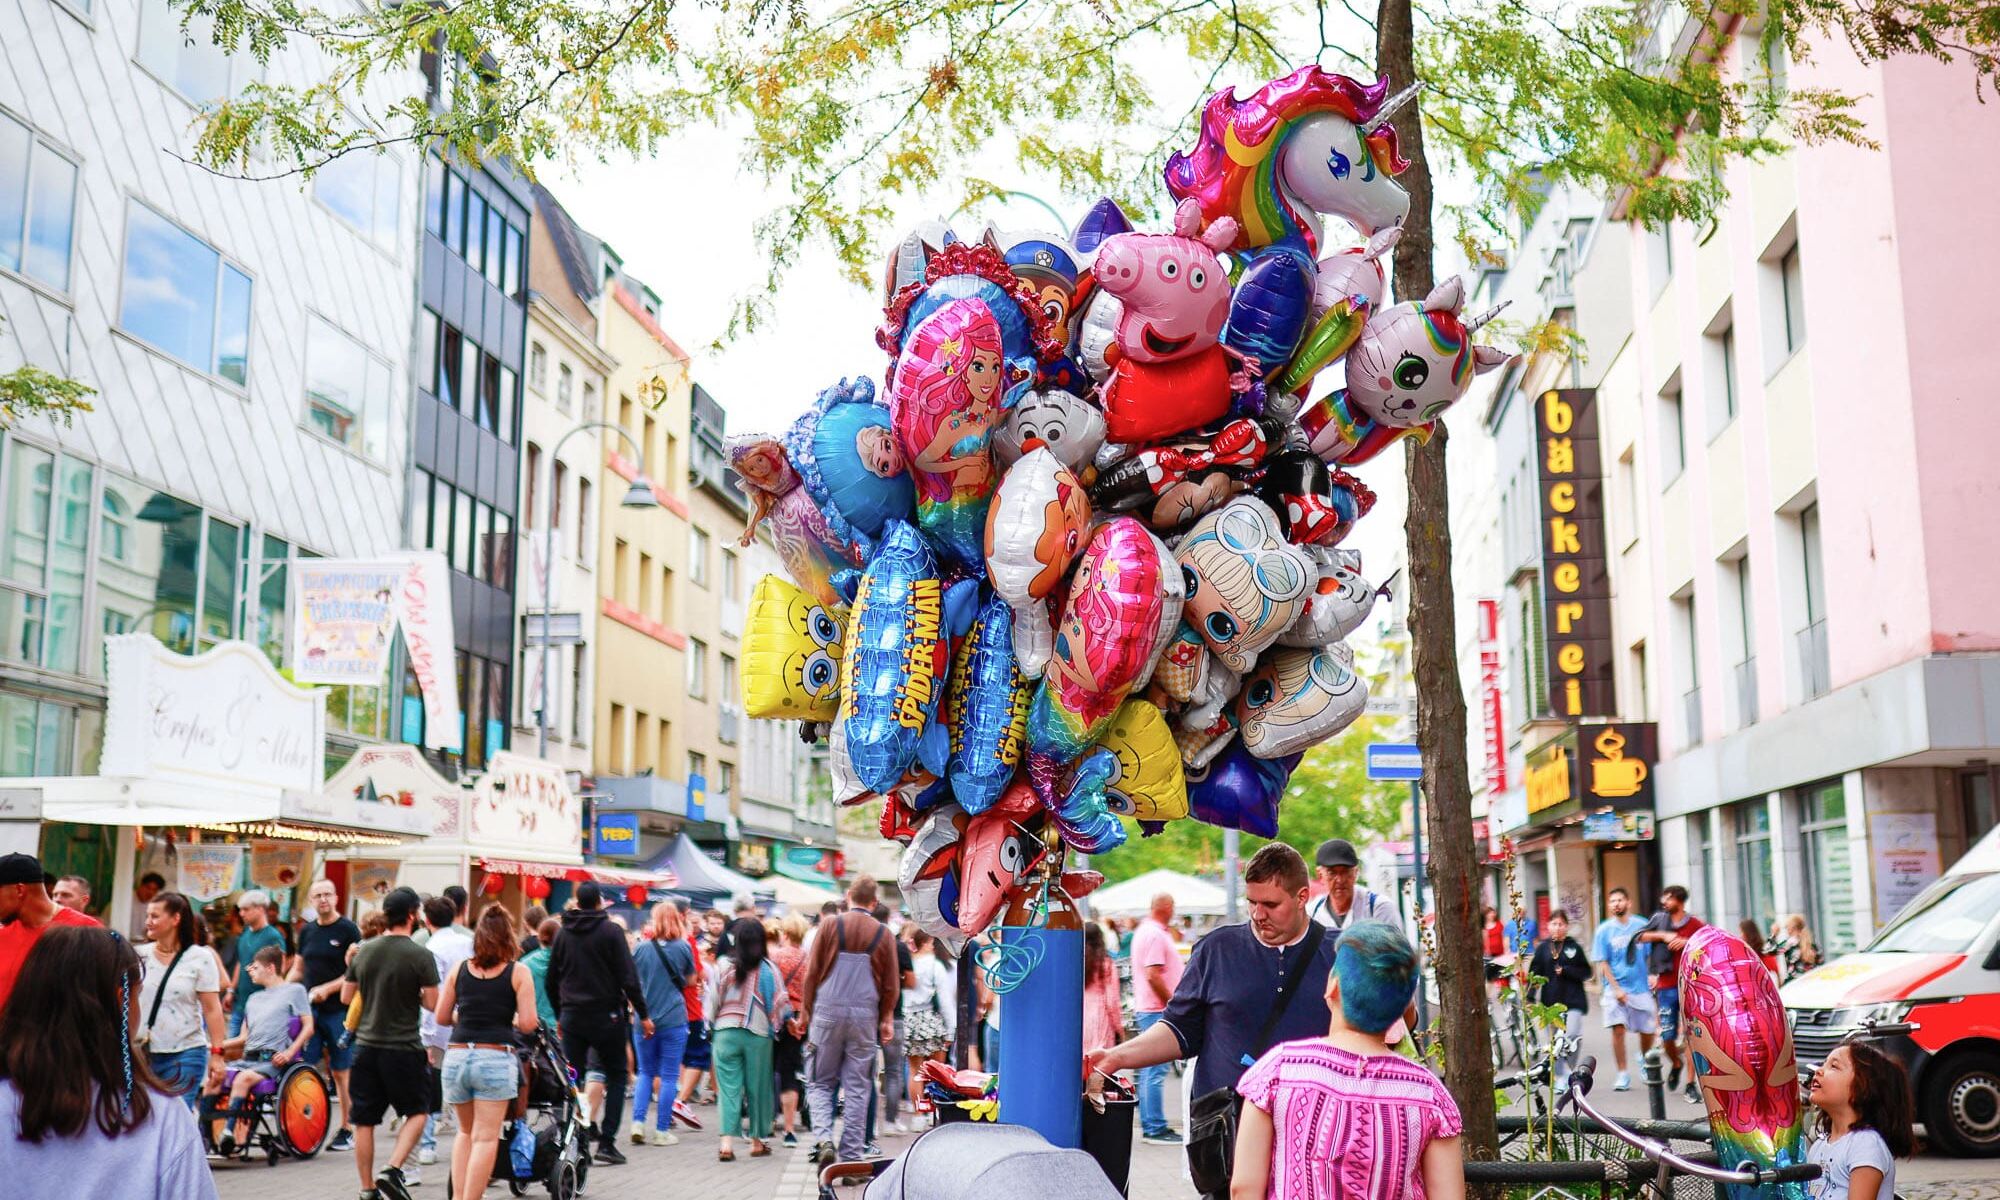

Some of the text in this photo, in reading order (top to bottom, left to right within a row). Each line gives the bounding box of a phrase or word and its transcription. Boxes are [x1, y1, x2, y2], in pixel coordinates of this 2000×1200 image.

[1544, 390, 1585, 716] bäckerei
[890, 580, 916, 720] THE AMAZING
[899, 579, 941, 738] SPIDER-MAN
[957, 623, 985, 751] THE AMAZING
[993, 726, 1009, 760] THE
